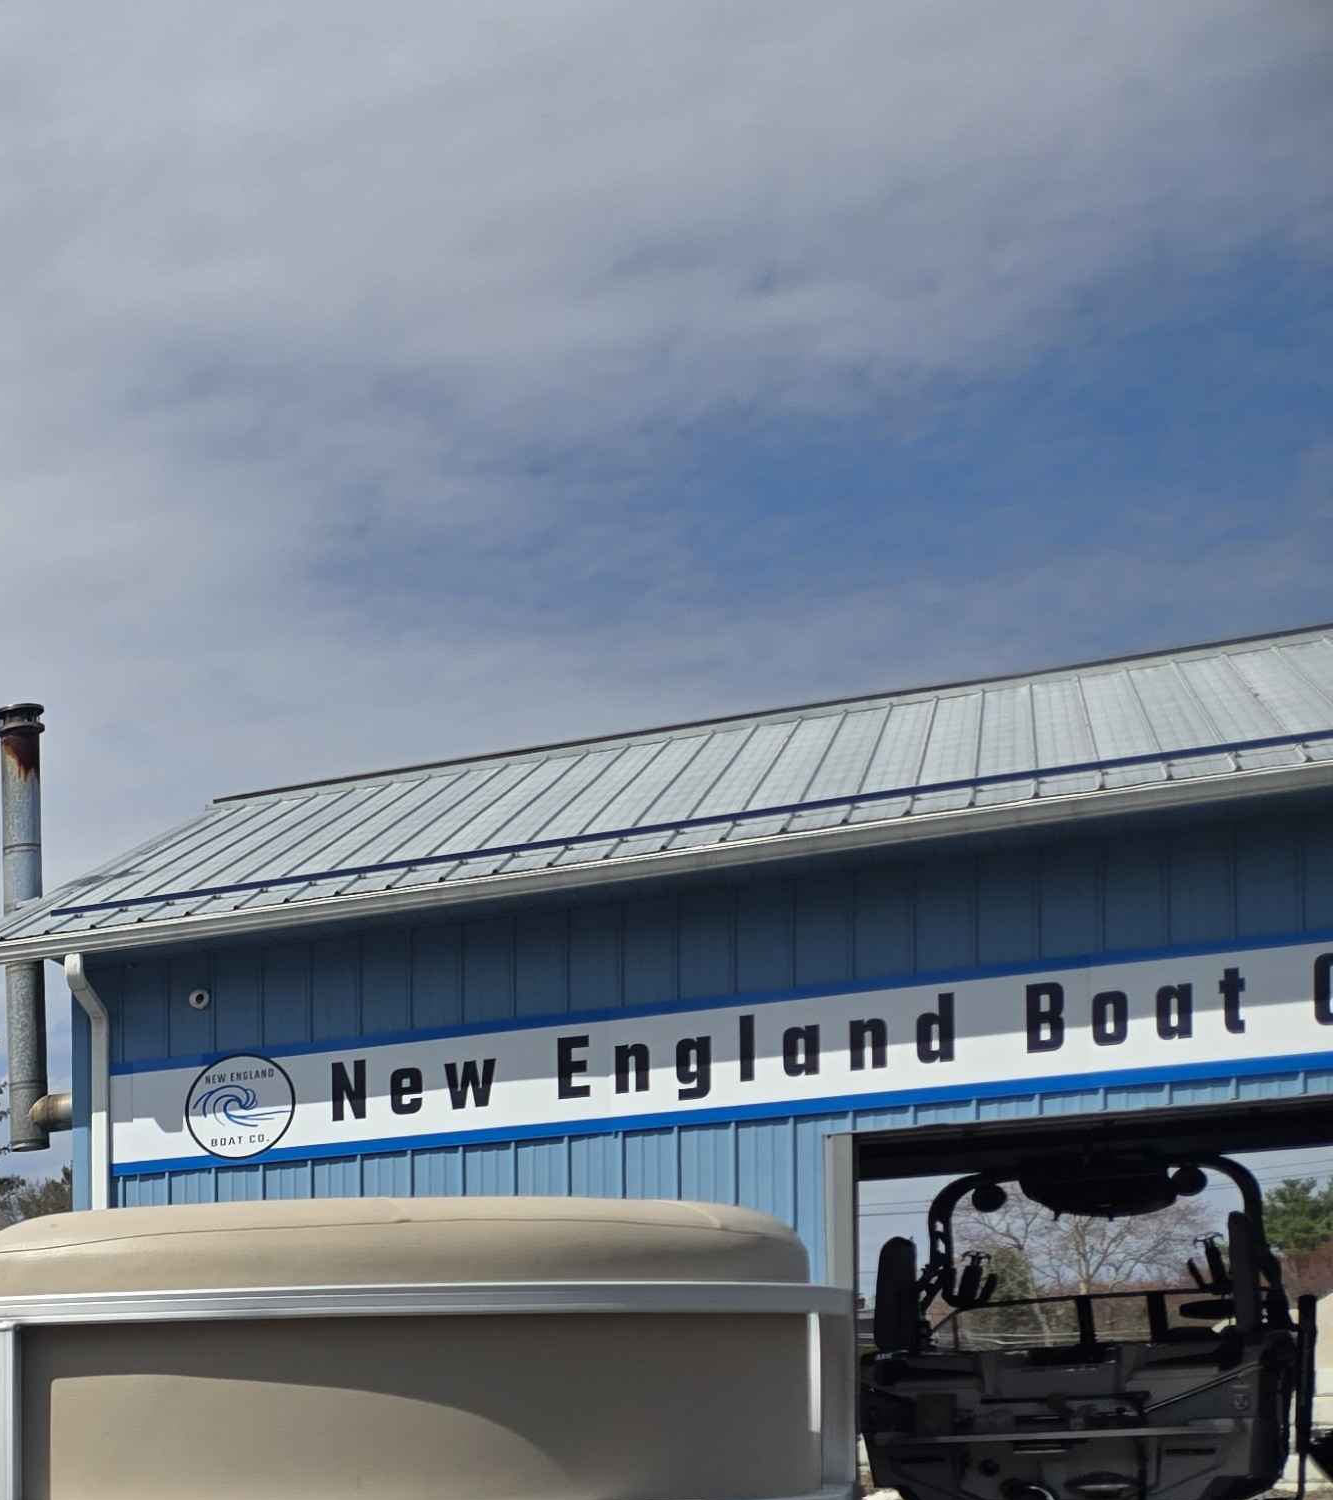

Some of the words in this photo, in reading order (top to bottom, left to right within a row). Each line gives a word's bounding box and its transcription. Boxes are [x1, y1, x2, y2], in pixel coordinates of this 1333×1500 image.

[331, 1038, 496, 1121] New
[557, 992, 955, 1101] England
[1026, 967, 1246, 1054] Boat
[205, 1073, 227, 1085] NEW
[230, 1067, 275, 1082] ENGLAND
[210, 1135, 244, 1147] BOAT
[249, 1134, 270, 1143] CO.
